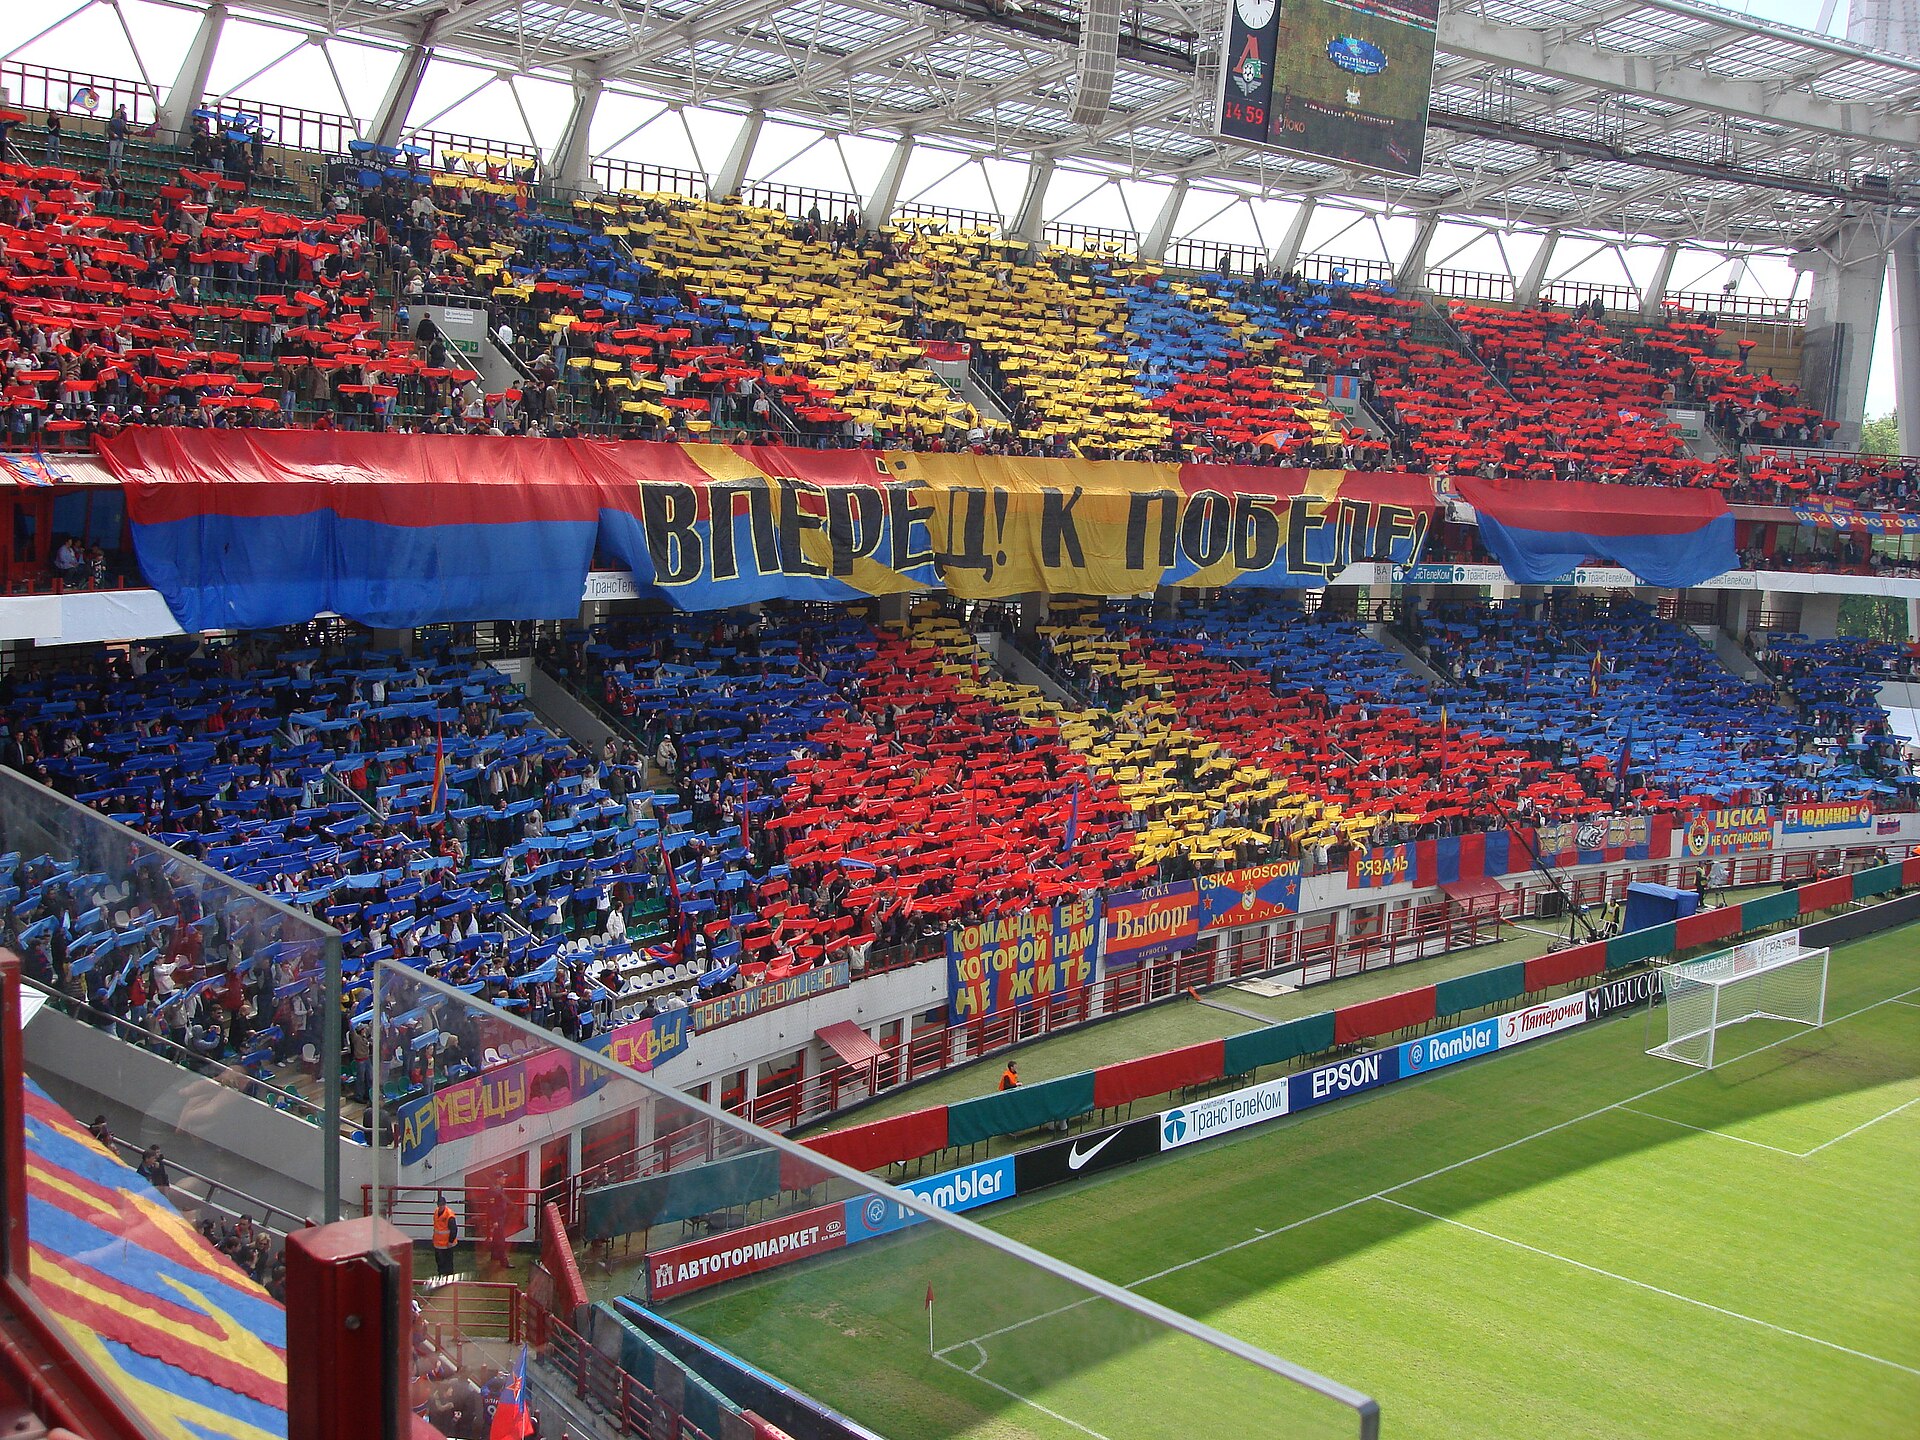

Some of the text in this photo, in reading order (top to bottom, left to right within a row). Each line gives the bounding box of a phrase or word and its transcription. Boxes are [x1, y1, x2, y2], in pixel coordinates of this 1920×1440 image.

[1246, 106, 1265, 125] 59
[1040, 486, 1087, 569] К
[1715, 807, 1767, 829] ЦСКА
[1801, 806, 1850, 828] ЮДИНО
[1711, 834, 1722, 846] НЕ
[1199, 860, 1300, 891] CSKA MOSCOW
[1355, 855, 1409, 877] РЯЗАНЬ
[1141, 883, 1170, 901] ЦСКА
[953, 898, 1095, 953] КОМАНДА, БЕЗ
[1115, 902, 1192, 942] Выборг
[1212, 902, 1285, 926] MITINO
[955, 924, 1095, 982] КОТОРОЙ НАМ
[955, 954, 1092, 1016] НЕ ЖИТЬ
[1603, 970, 1663, 1011] MEUCCI
[1429, 1028, 1492, 1063] Rambler
[1312, 1055, 1379, 1100] EPSON
[402, 1072, 526, 1153] АРМЕЙЦЫ
[1190, 1090, 1282, 1136] ТрансТелеКом
[677, 1226, 820, 1282] АВТОТОРМАРКЕТ
